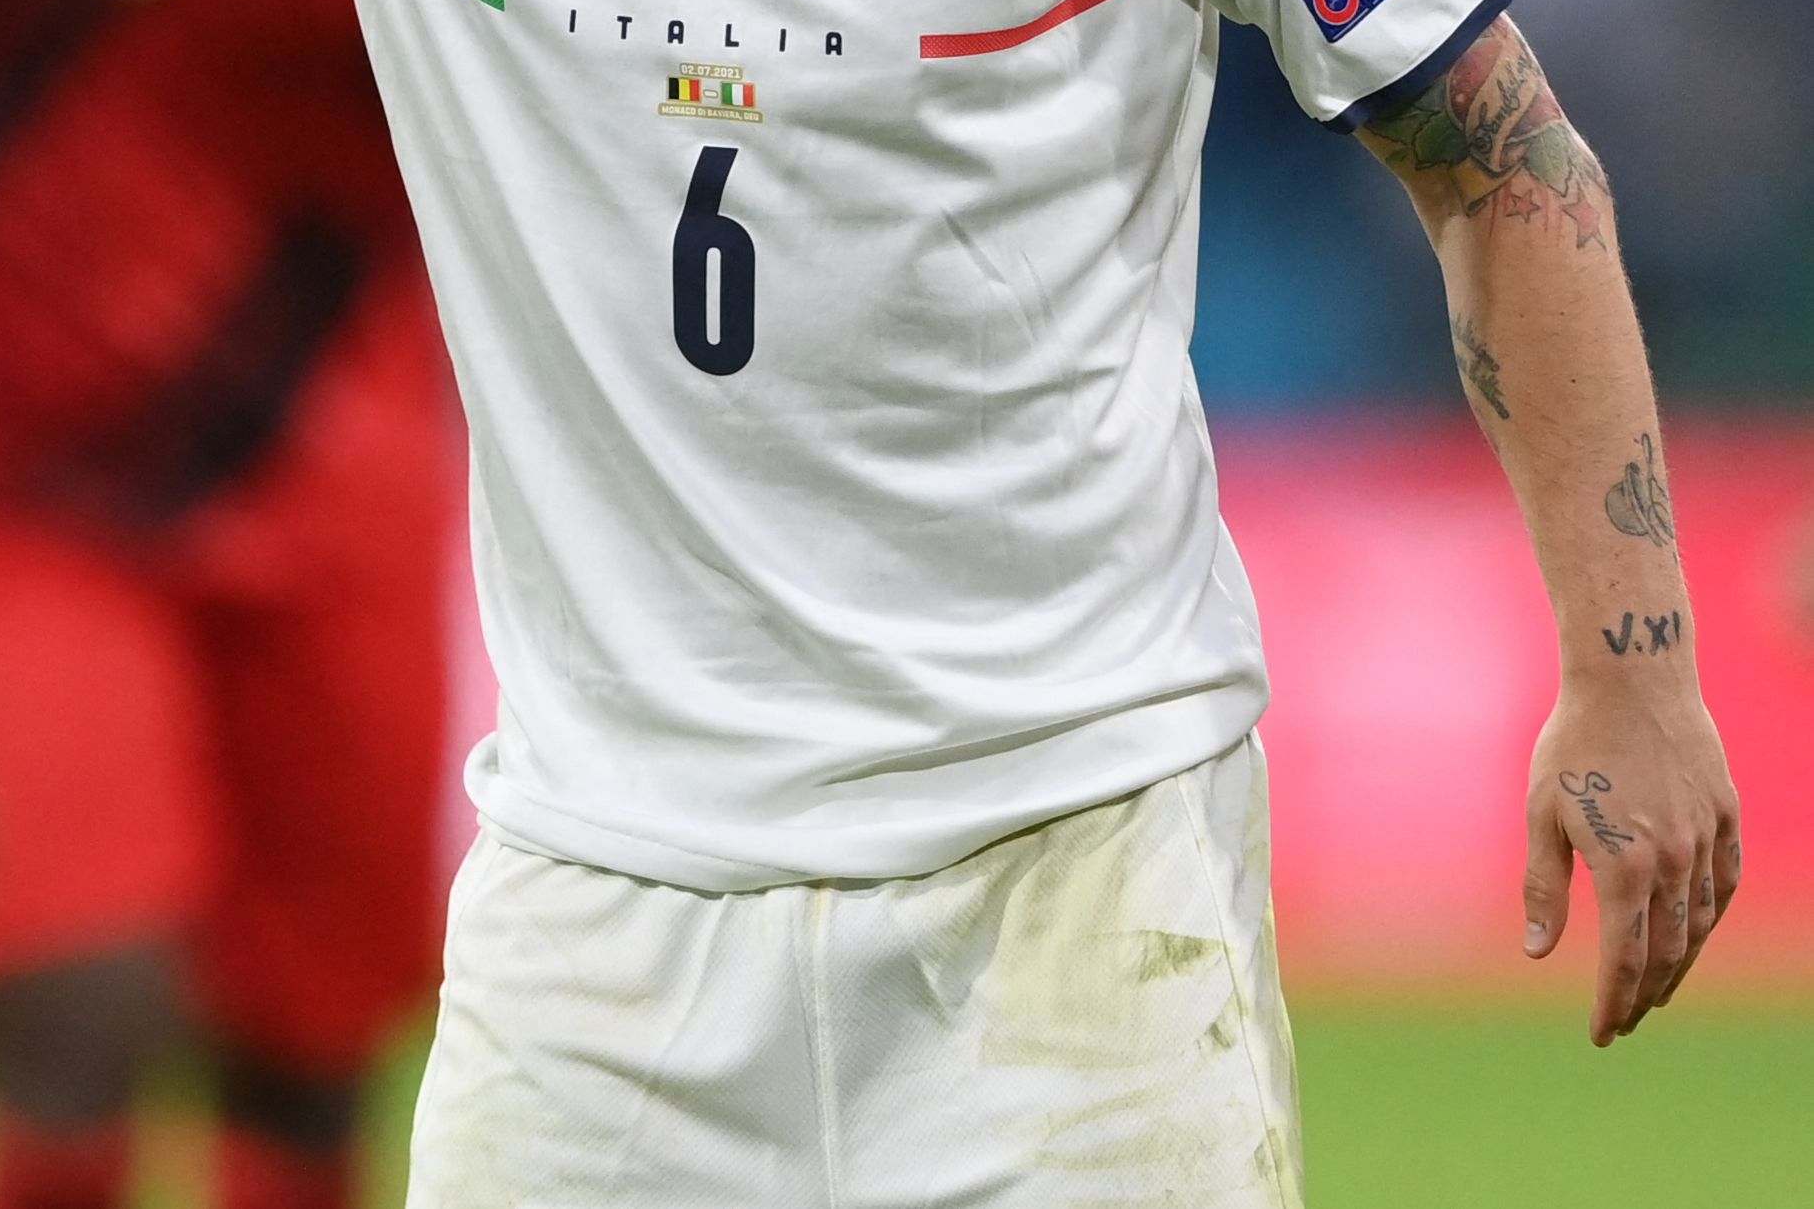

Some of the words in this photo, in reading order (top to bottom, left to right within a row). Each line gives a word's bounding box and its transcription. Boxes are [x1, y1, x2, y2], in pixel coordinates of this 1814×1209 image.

[568, 8, 843, 56] ITALIA
[681, 64, 741, 79] 02.07.2021
[661, 105, 696, 115] MONACO
[672, 145, 756, 377] 6
[1558, 770, 1635, 856] Smile
